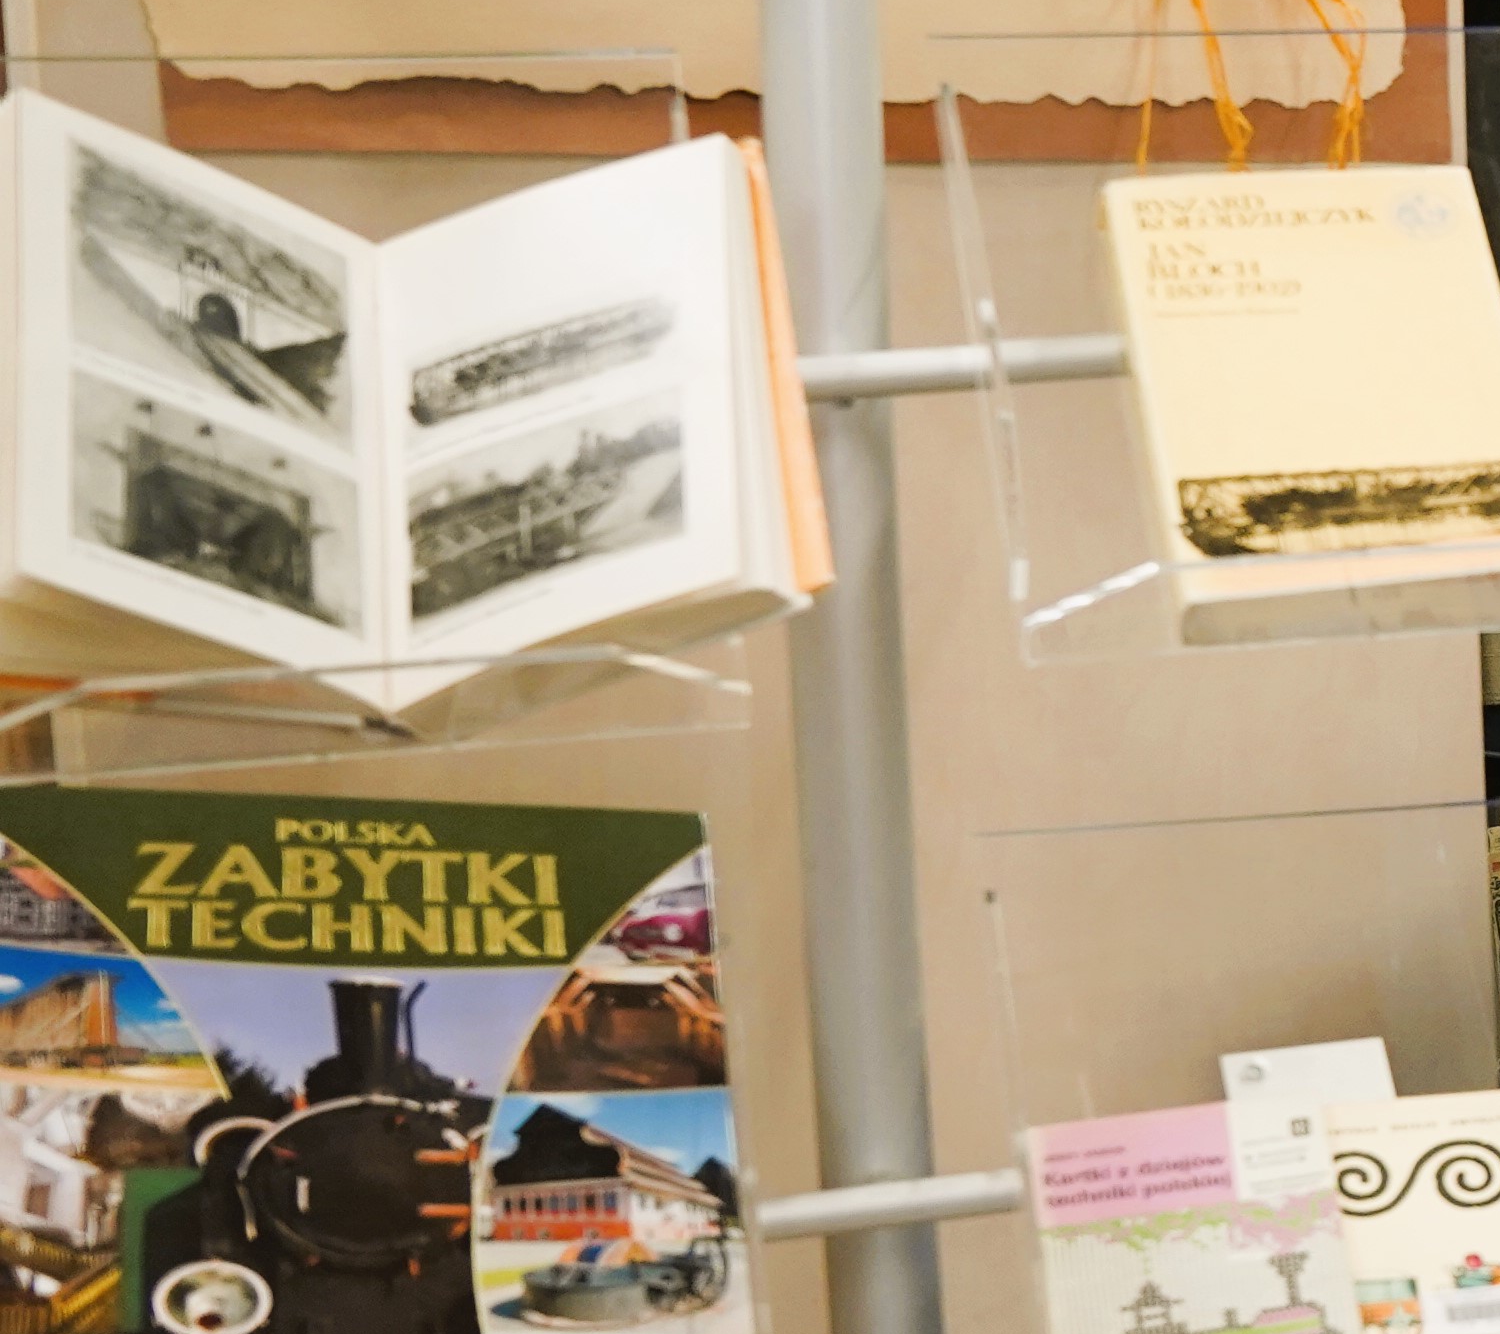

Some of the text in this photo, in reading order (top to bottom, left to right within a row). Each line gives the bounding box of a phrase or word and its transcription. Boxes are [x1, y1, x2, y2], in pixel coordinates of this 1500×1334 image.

[274, 817, 437, 846] POLSKA
[135, 842, 559, 906] ZABYTKI
[127, 898, 568, 958] TECHNIKI
